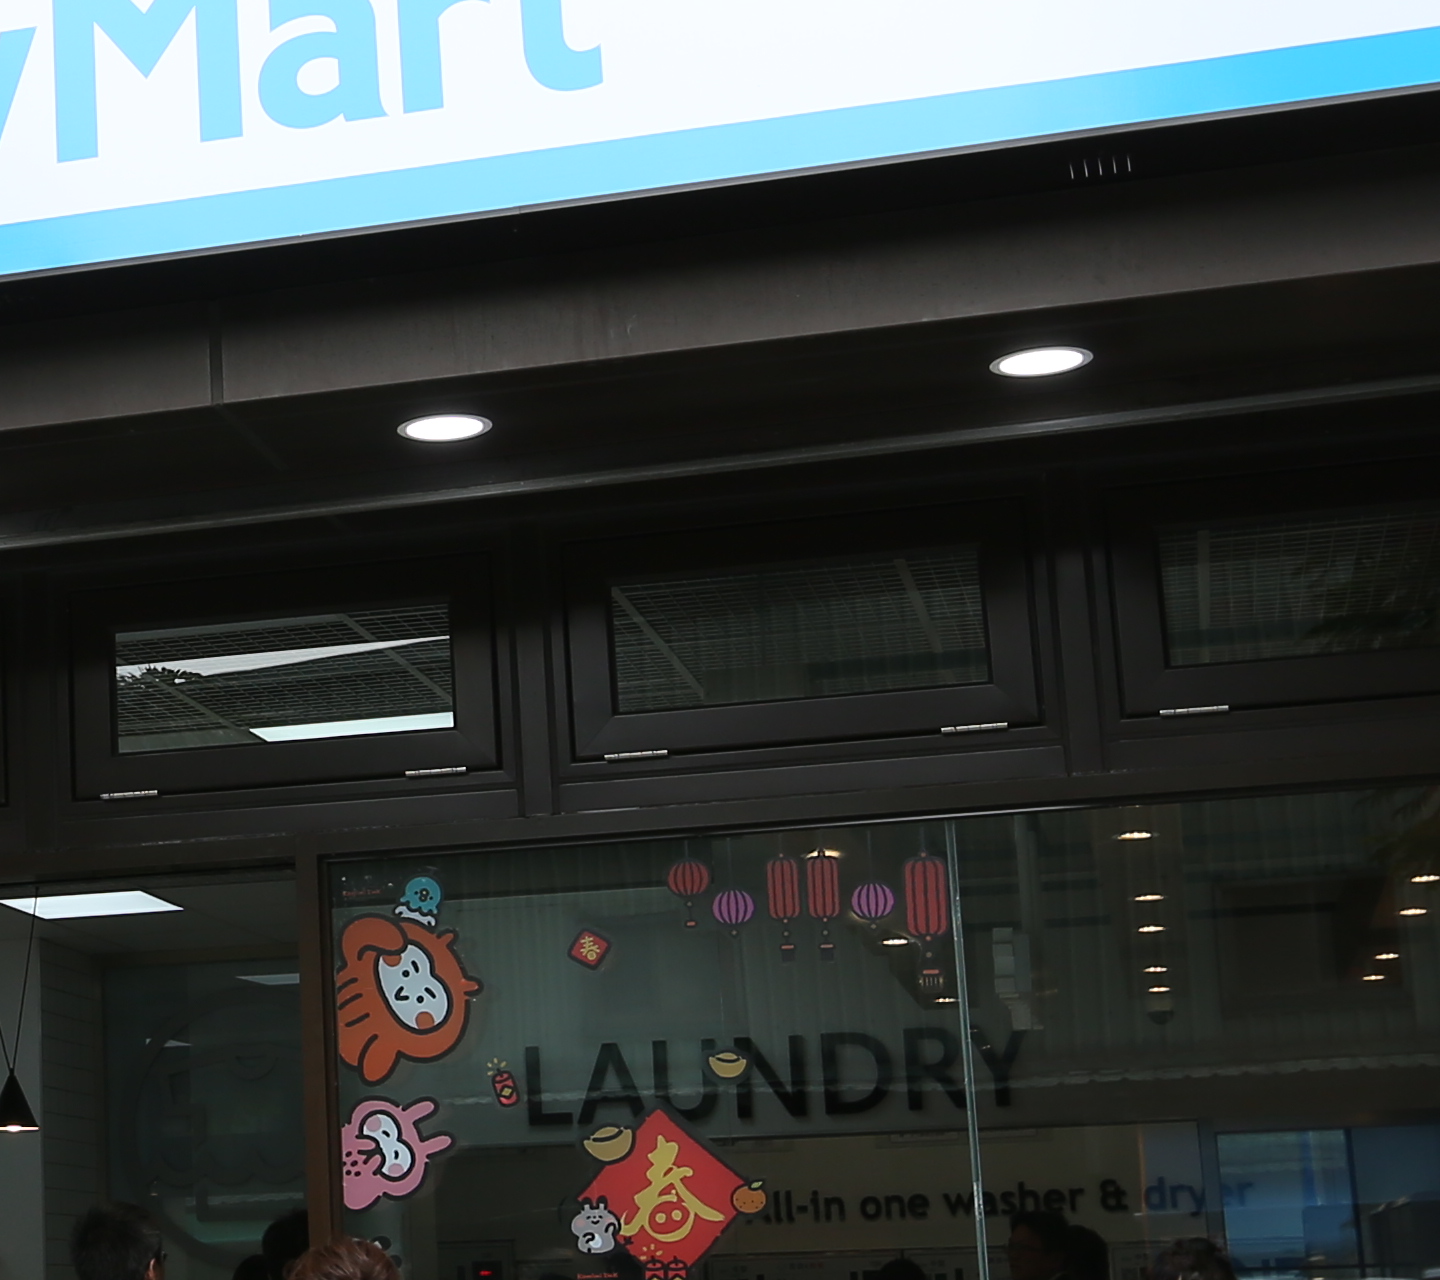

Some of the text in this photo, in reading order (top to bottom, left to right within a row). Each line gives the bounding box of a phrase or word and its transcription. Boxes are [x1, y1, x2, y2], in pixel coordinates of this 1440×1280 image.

[524, 1027, 1029, 1126] LAUNDRY
[622, 1135, 725, 1241] 春
[746, 1175, 1253, 1225] ll-in one washer & dryer
